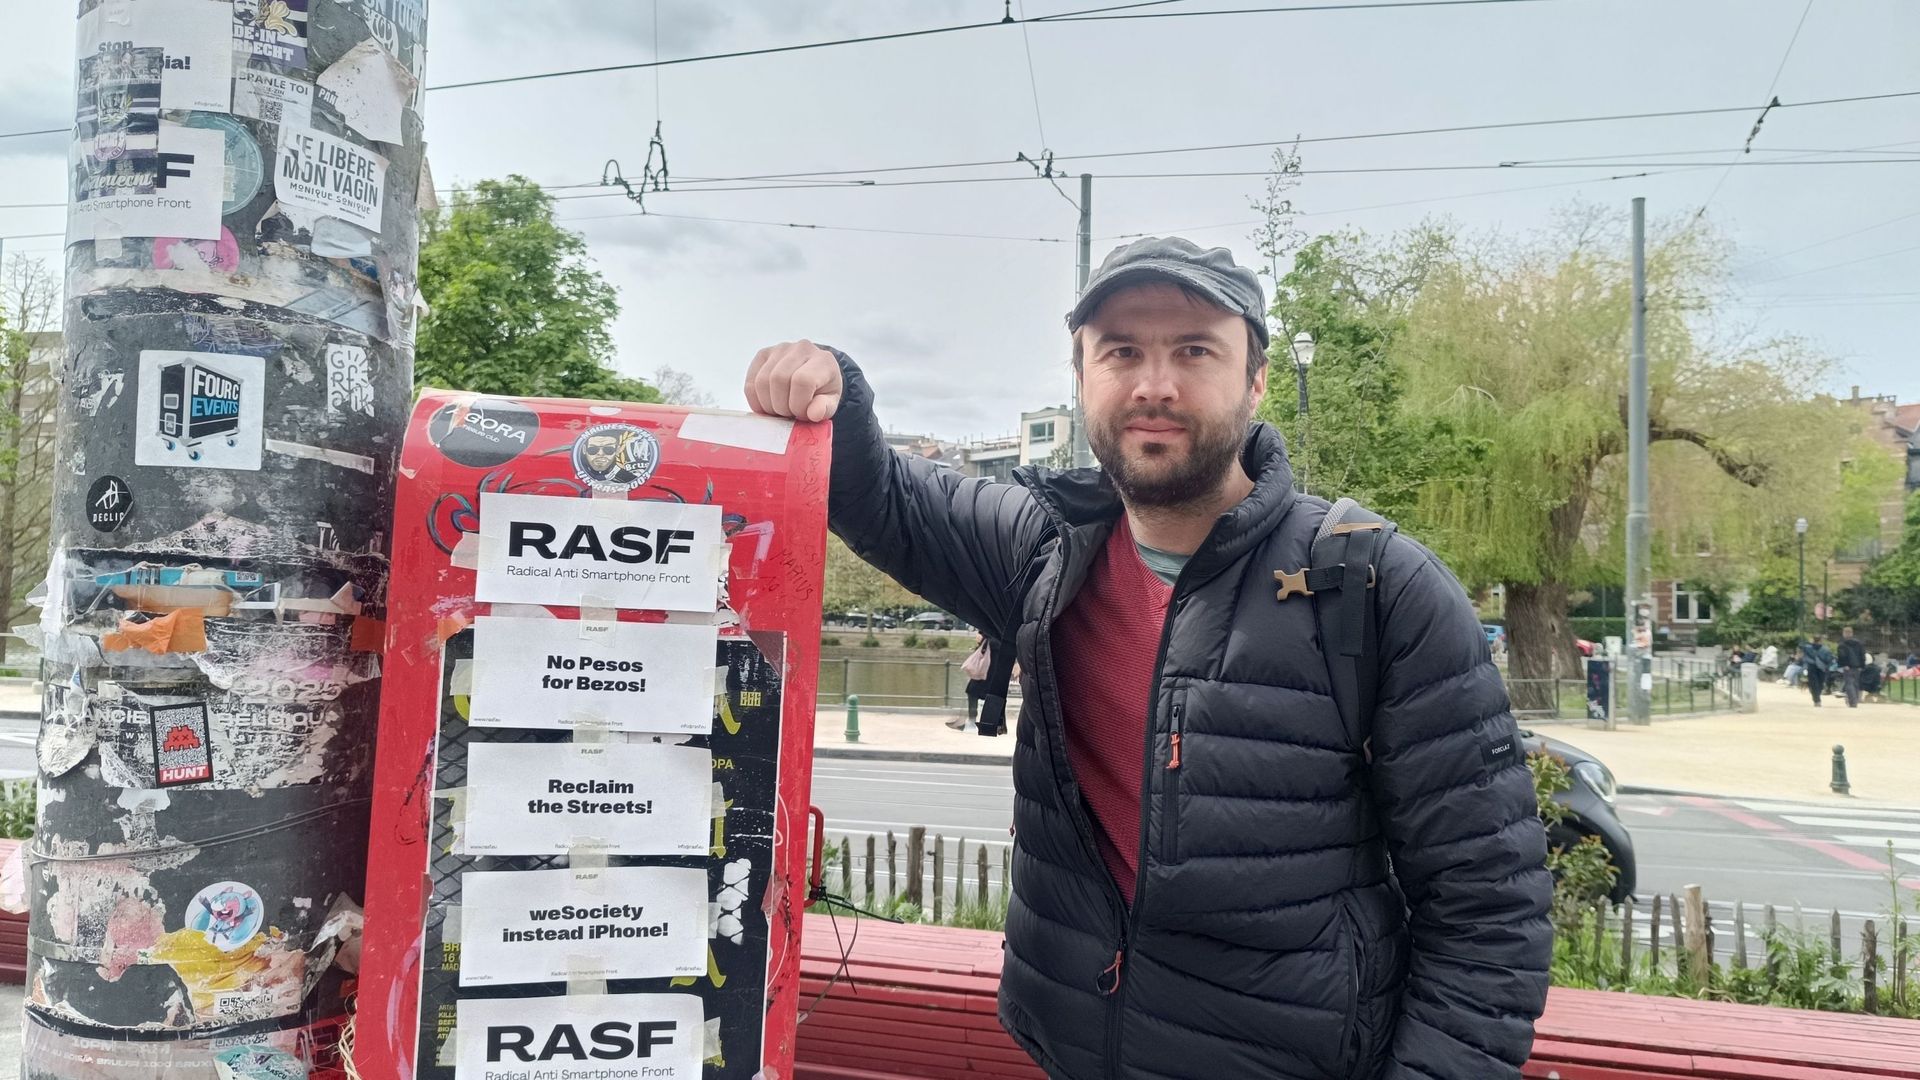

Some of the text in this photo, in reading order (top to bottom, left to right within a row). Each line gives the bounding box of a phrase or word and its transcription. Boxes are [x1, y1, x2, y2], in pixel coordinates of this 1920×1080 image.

[289, 82, 309, 96] TOI
[318, 141, 376, 183] LIBÈRE
[283, 155, 378, 208] MON VAGIN
[93, 197, 154, 211] Smartphone
[157, 197, 191, 209] Front
[290, 182, 333, 201] MONIQUE
[336, 195, 371, 215] SONIQUE
[192, 397, 239, 417] EVENTS
[93, 512, 125, 522] DECLIC
[509, 521, 694, 564] RASF
[507, 565, 691, 584] Radical Anti Smartphone Front
[547, 655, 643, 673] No Pesos
[542, 675, 646, 693] for Bezos!
[1491, 743, 1510, 755] FORCLAZ
[162, 765, 207, 781] HUNT
[548, 779, 634, 794] Reclaim
[527, 799, 653, 814] the Streets!
[529, 904, 644, 921] weSociety
[502, 922, 669, 943] instead iPhone!
[487, 1021, 677, 1062] RASF
[485, 1066, 675, 1080] Radical Anti Smartphone Front
